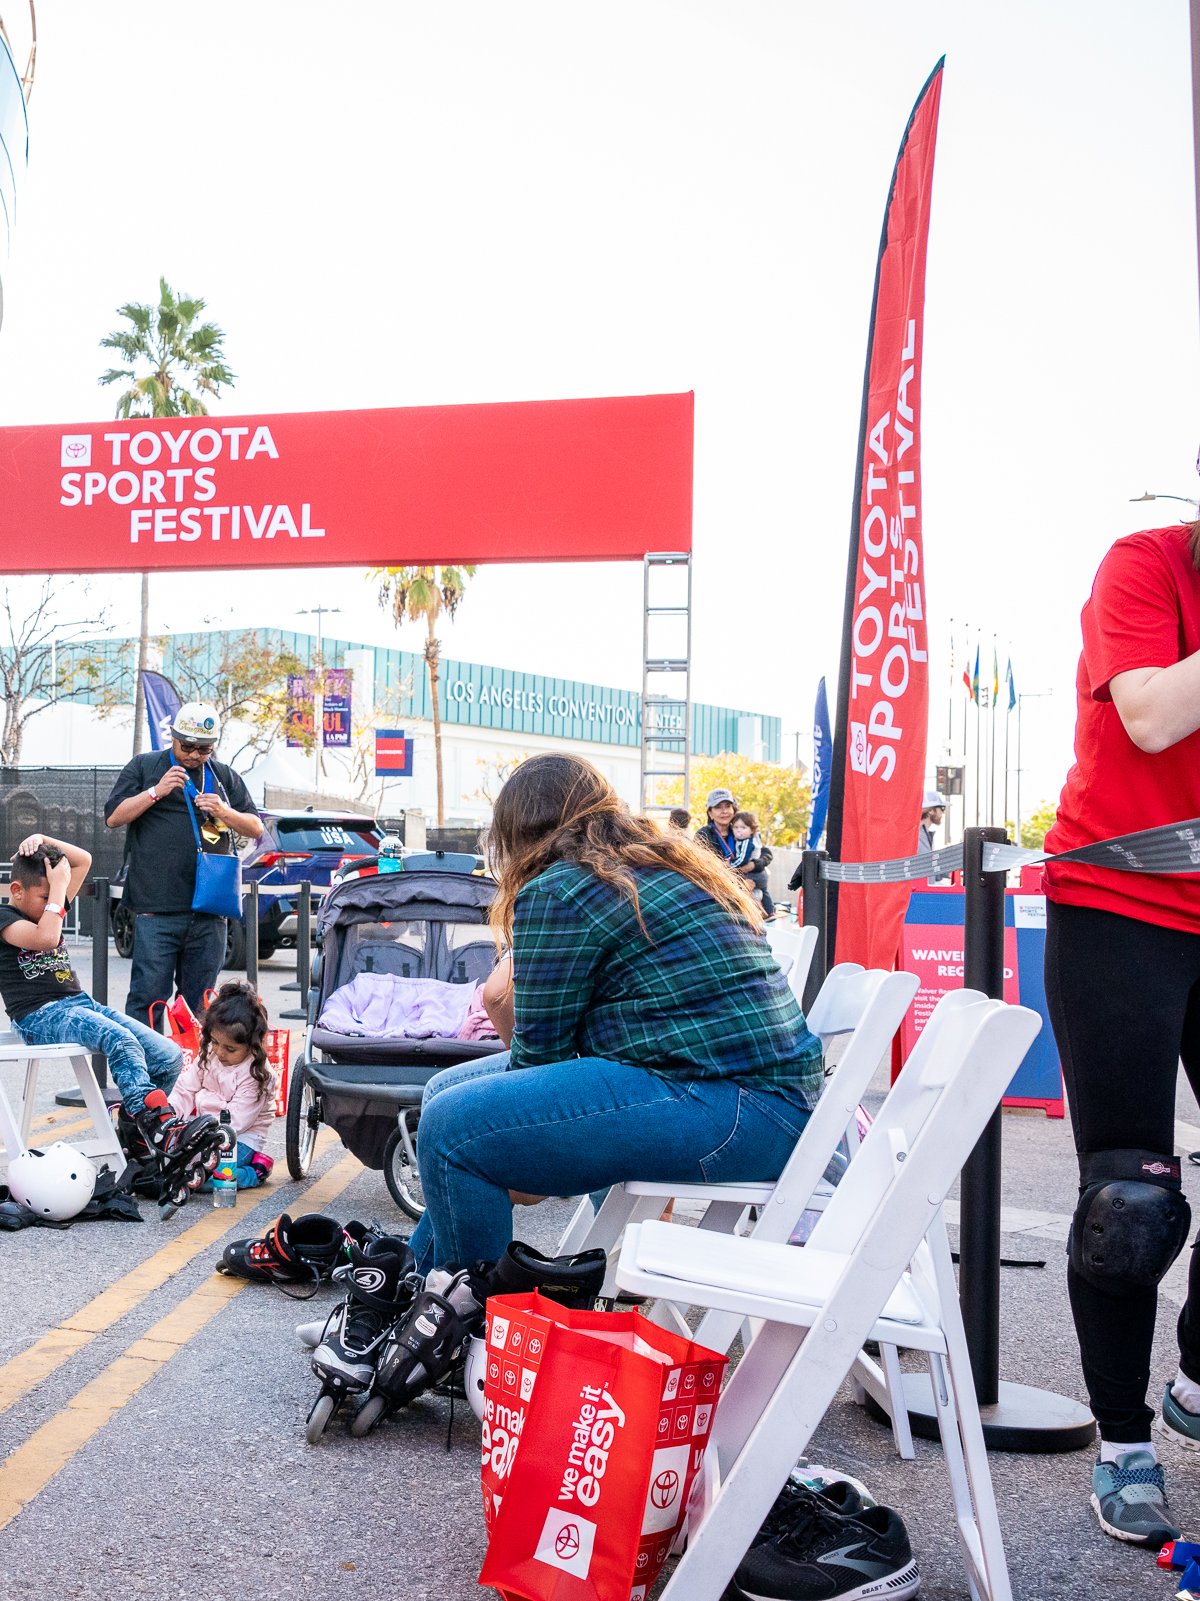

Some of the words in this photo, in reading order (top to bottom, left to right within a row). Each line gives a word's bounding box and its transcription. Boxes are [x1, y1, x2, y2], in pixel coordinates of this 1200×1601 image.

[104, 426, 280, 466] TOYOTA
[60, 467, 217, 507] SPORTS
[893, 319, 929, 664] FESTIVAL
[130, 503, 326, 543] FESTIVAL
[851, 410, 891, 699] TOYOTA
[865, 514, 911, 783] SPORTS
[446, 679, 475, 704] LOS
[479, 685, 544, 715] ANGELES
[548, 695, 636, 726] CONVENTION
[638, 710, 683, 731] NTER
[321, 831, 355, 846] USA
[580, 1384, 601, 1403] it
[496, 1403, 525, 1435] mak
[568, 1403, 597, 1467] make
[576, 1389, 626, 1507] easy
[558, 1467, 579, 1501] we
[822, 1551, 840, 1561] BROOKS
[861, 1584, 883, 1595] BEAST
